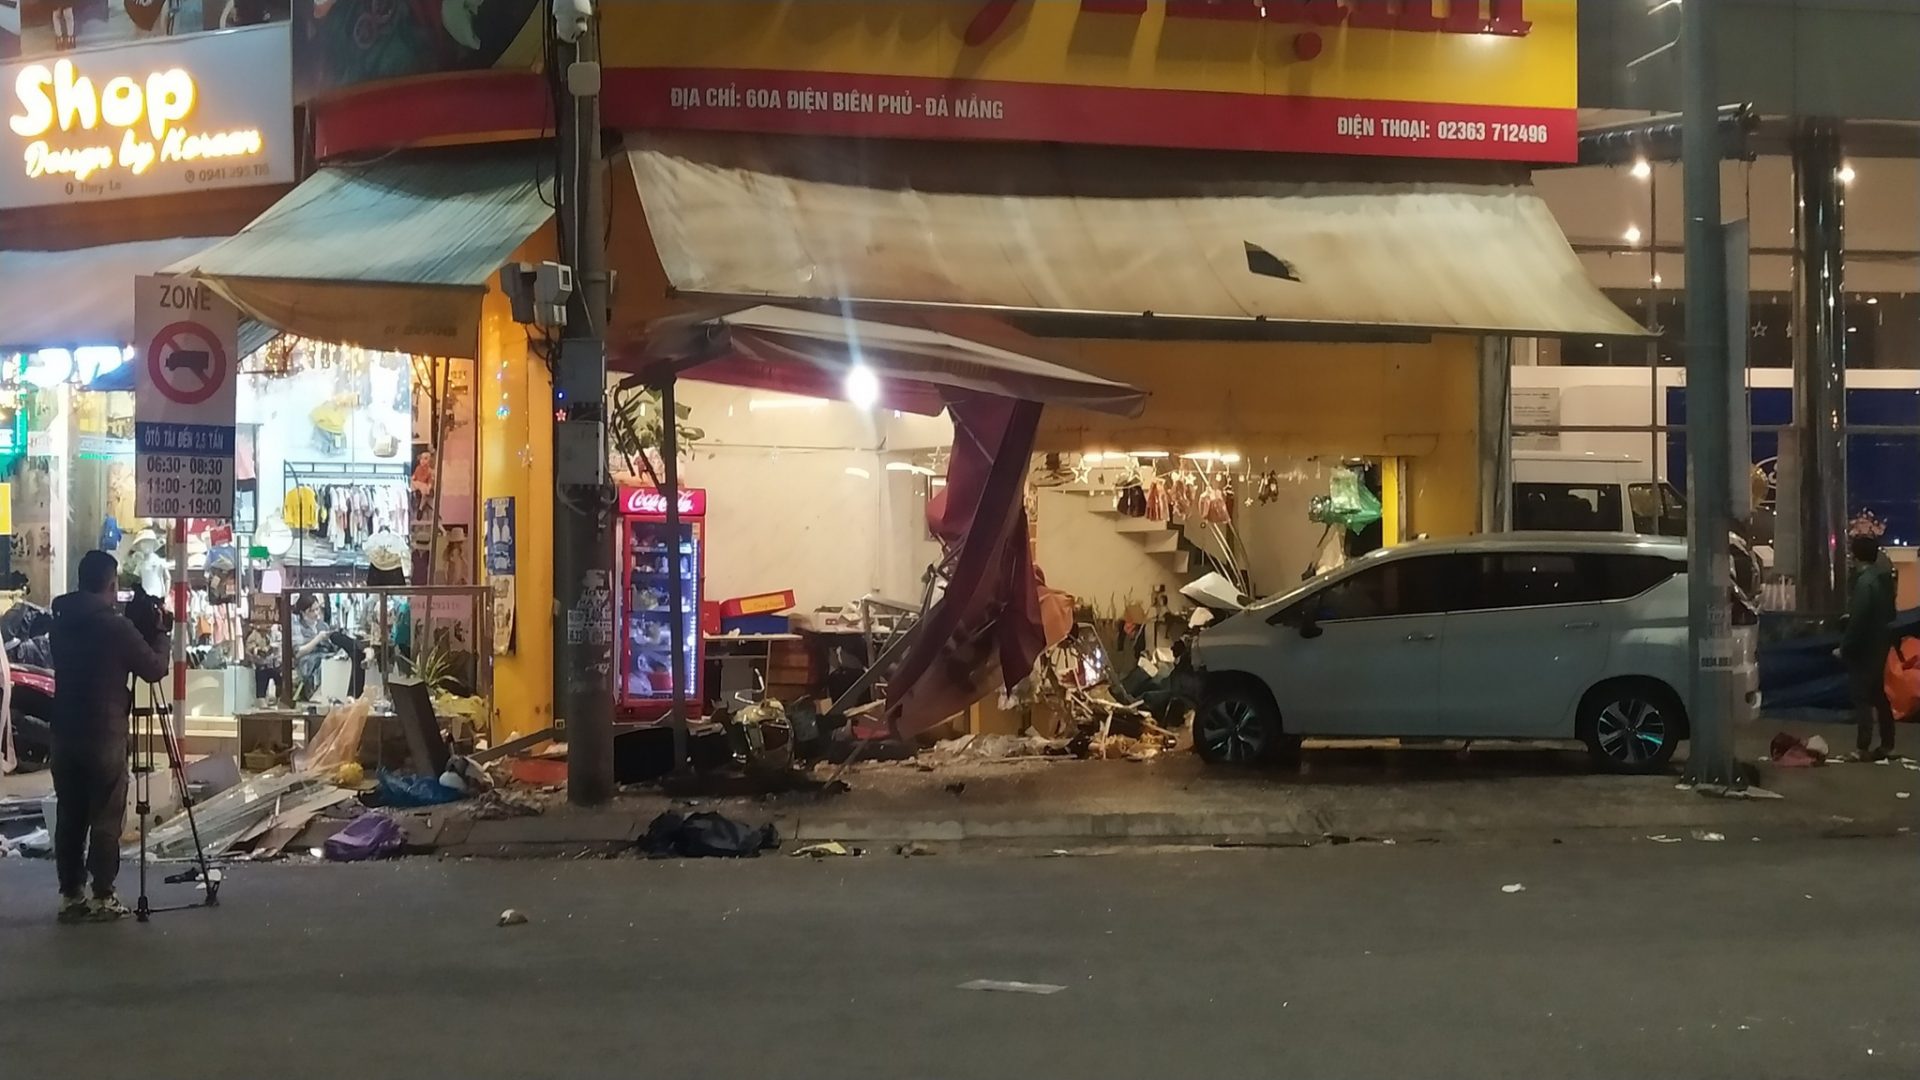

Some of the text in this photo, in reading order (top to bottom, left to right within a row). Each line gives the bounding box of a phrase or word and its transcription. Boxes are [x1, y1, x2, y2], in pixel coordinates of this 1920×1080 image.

[9, 58, 197, 140] Shop
[671, 87, 701, 110] ĐỊA
[706, 82, 741, 108] CHỈ:
[787, 86, 828, 114] ĐIỆN
[832, 89, 873, 113] BIÊN
[878, 90, 913, 115] PHỦ
[1337, 113, 1548, 144] ĐIỆN THOẠI: 02363 712496
[118, 128, 156, 175] by
[160, 284, 211, 311] ZONE
[147, 456, 180, 473] 06:30
[190, 458, 223, 475] 08:30
[147, 477, 180, 494] 11:00
[189, 479, 222, 495] 12:00
[147, 496, 180, 514] 16:00
[189, 498, 221, 515] 19:00
